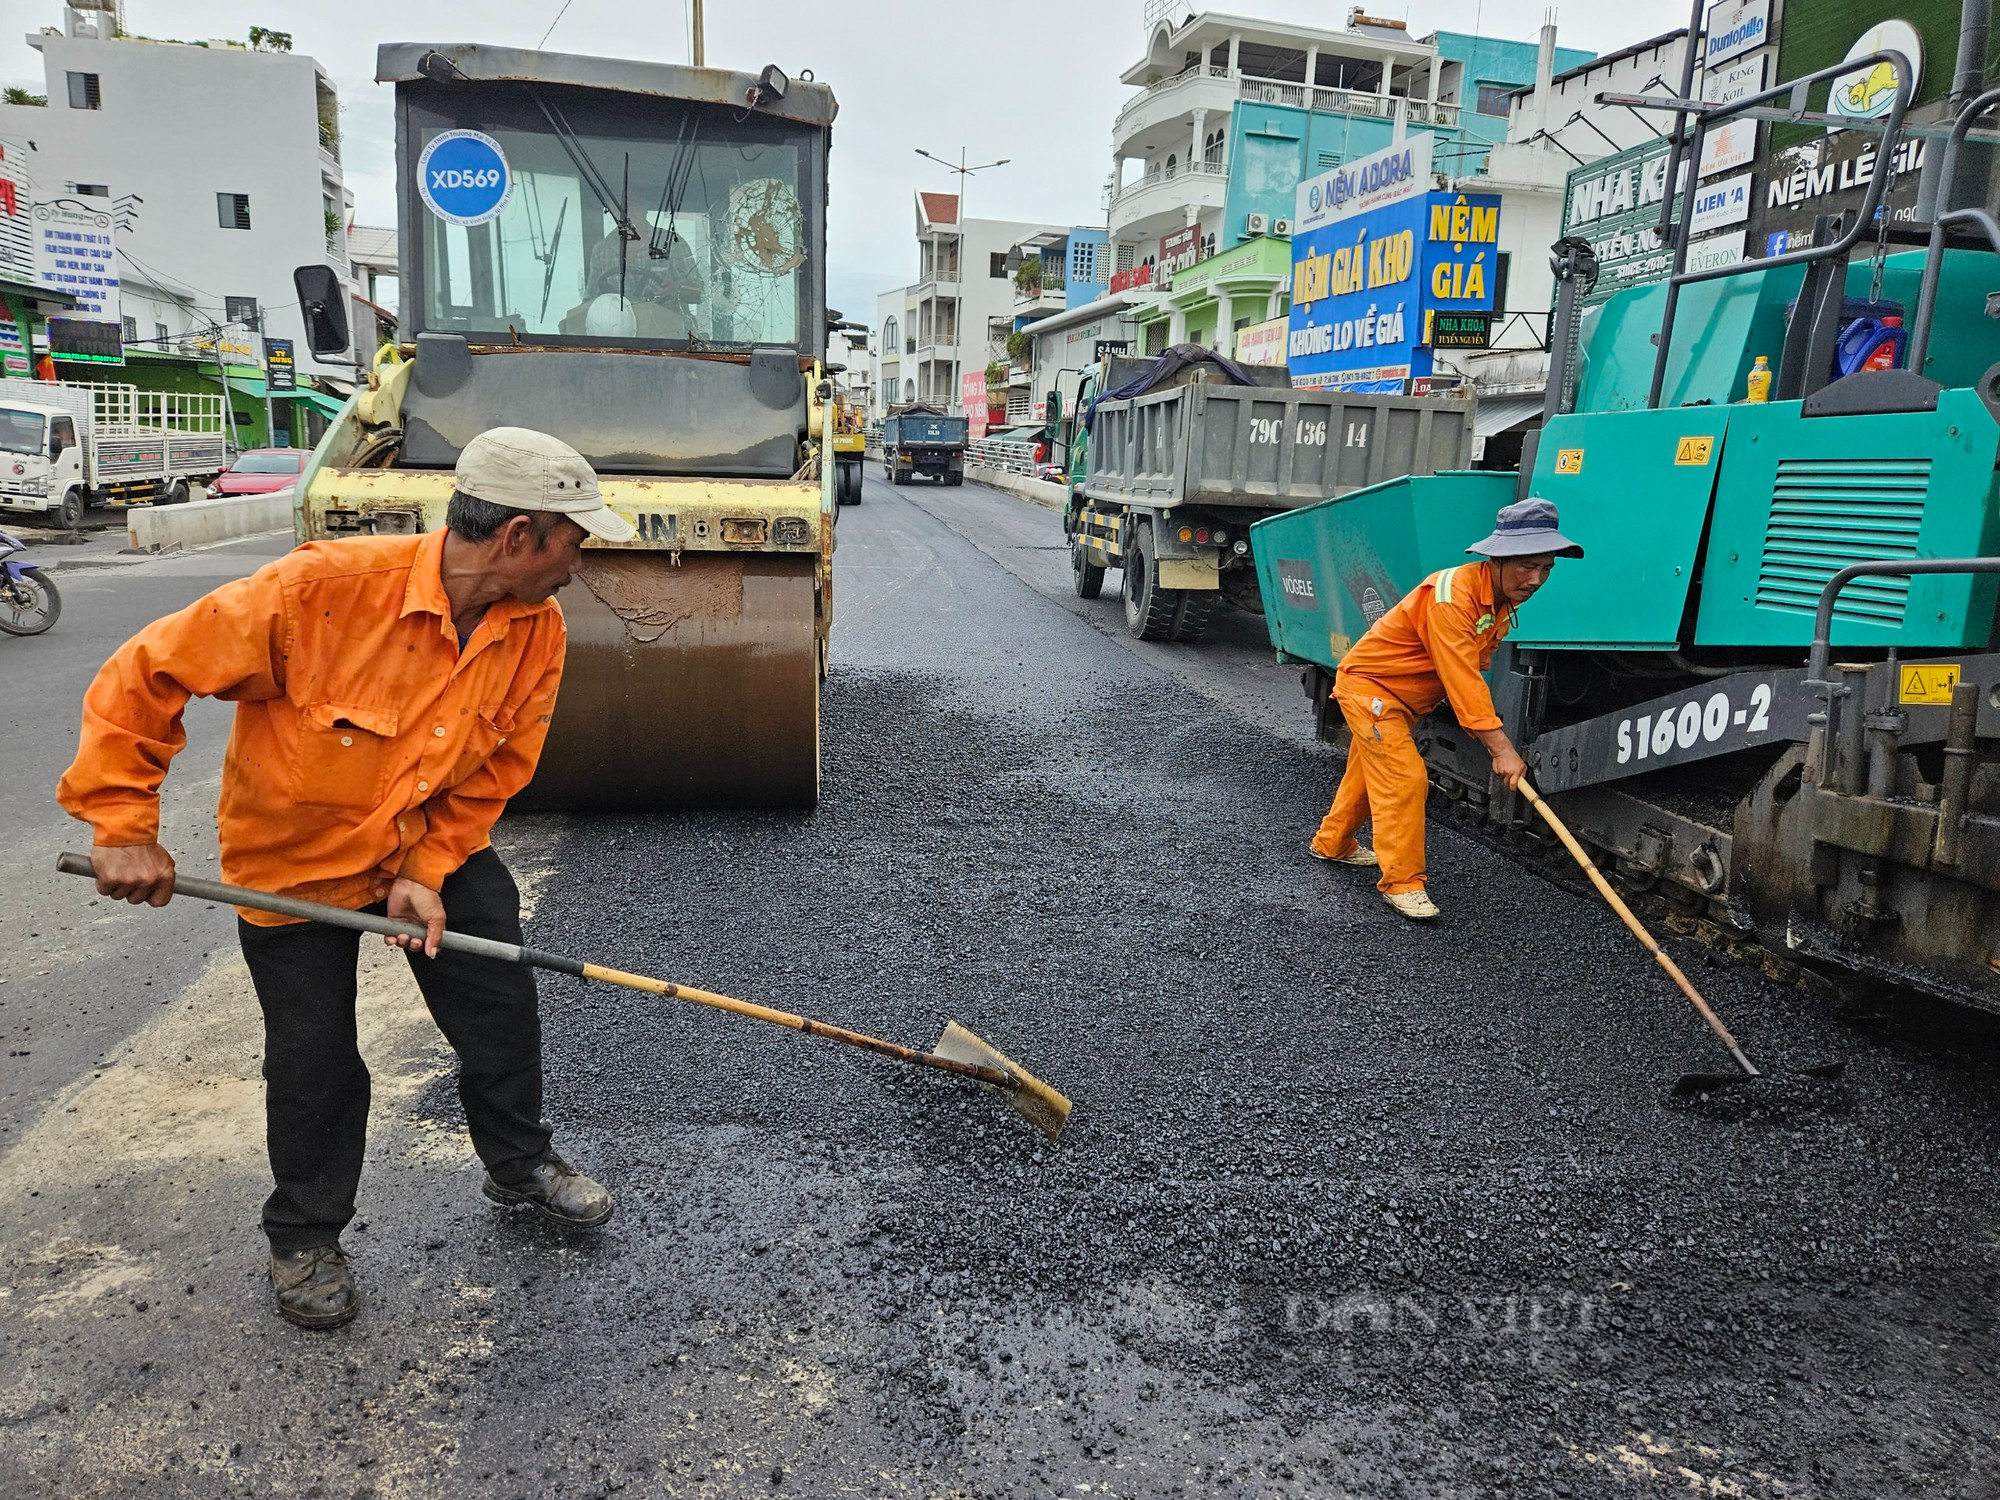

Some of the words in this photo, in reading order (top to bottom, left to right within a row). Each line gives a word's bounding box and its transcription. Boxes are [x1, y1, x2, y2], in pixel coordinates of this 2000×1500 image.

[1709, 16, 1764, 56] Dunlopillo
[1728, 65, 1754, 83] KING
[1722, 87, 1745, 103] KOIL
[431, 169, 500, 189] XD569
[1326, 168, 1357, 210] NỆM
[1358, 147, 1413, 197] ADORA
[1768, 164, 1835, 211] NỆM
[1839, 142, 1877, 190] LẺ
[1570, 167, 1634, 226] NHA
[1696, 191, 1727, 215] LIEN
[1428, 194, 1498, 253] NỆM
[1293, 246, 1331, 315] NỆM
[1331, 228, 1367, 296] GIÁ
[1368, 229, 1414, 289] KHO
[1431, 252, 1486, 299] GIÁ
[1690, 247, 1738, 272] EVERON
[1289, 320, 1333, 358] KHÔNG
[1333, 320, 1354, 351] LO
[1355, 303, 1378, 348] VỀ
[1375, 302, 1406, 345] GIÁ
[1439, 318, 1458, 331] NHA
[1460, 318, 1485, 332] KHOA
[1097, 342, 1126, 358] SẢNH
[1249, 418, 1283, 446] 79C
[1295, 419, 1327, 447] 136
[1345, 422, 1367, 448] 14
[1282, 575, 1315, 597] VÖGELE
[1617, 683, 1772, 765] S1600-2
